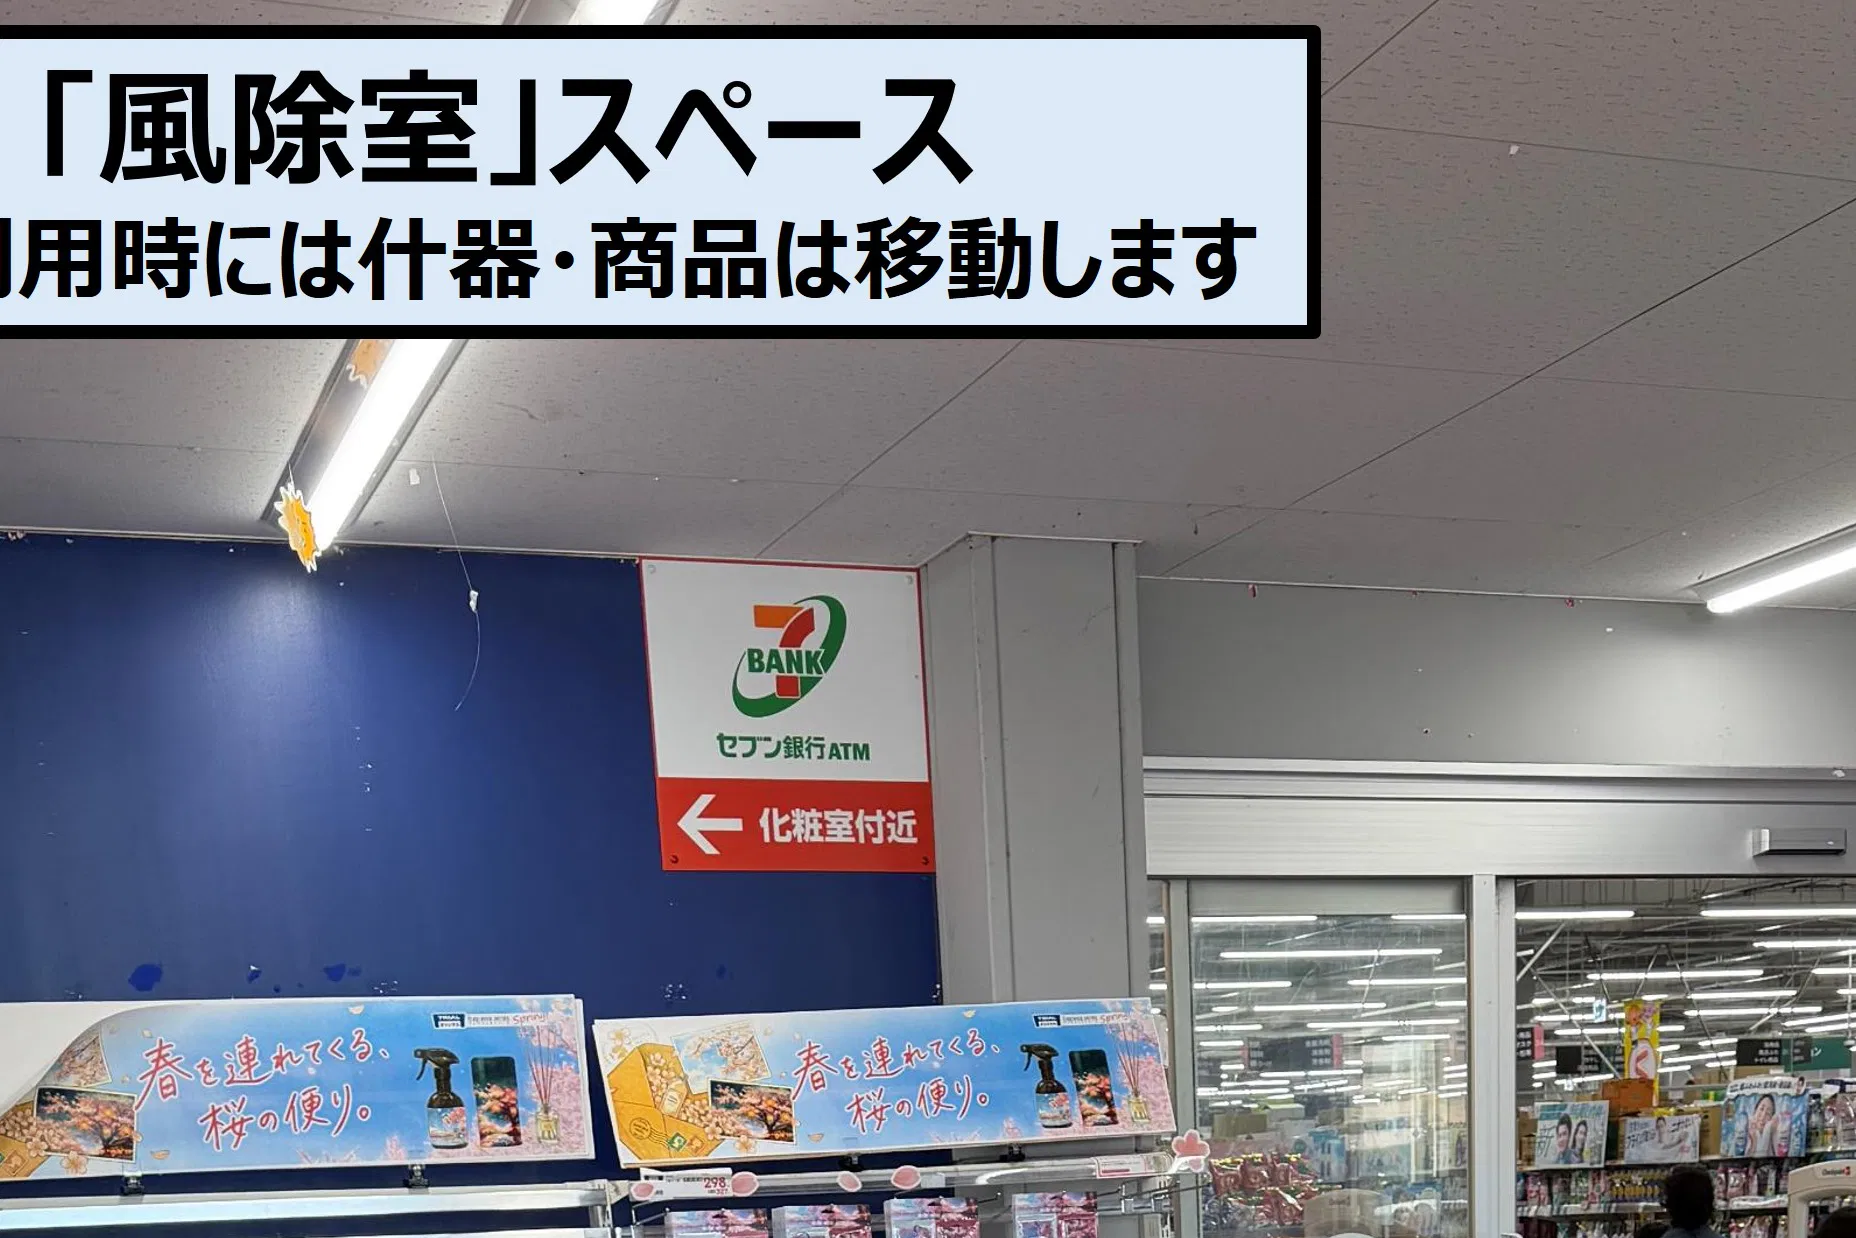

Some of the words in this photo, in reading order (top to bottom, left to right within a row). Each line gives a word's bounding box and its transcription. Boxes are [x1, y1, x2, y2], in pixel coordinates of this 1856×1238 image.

[746, 648, 824, 679] BANK
[716, 733, 870, 763] セブン銀行ATM
[759, 808, 918, 846] 化粧室付近
